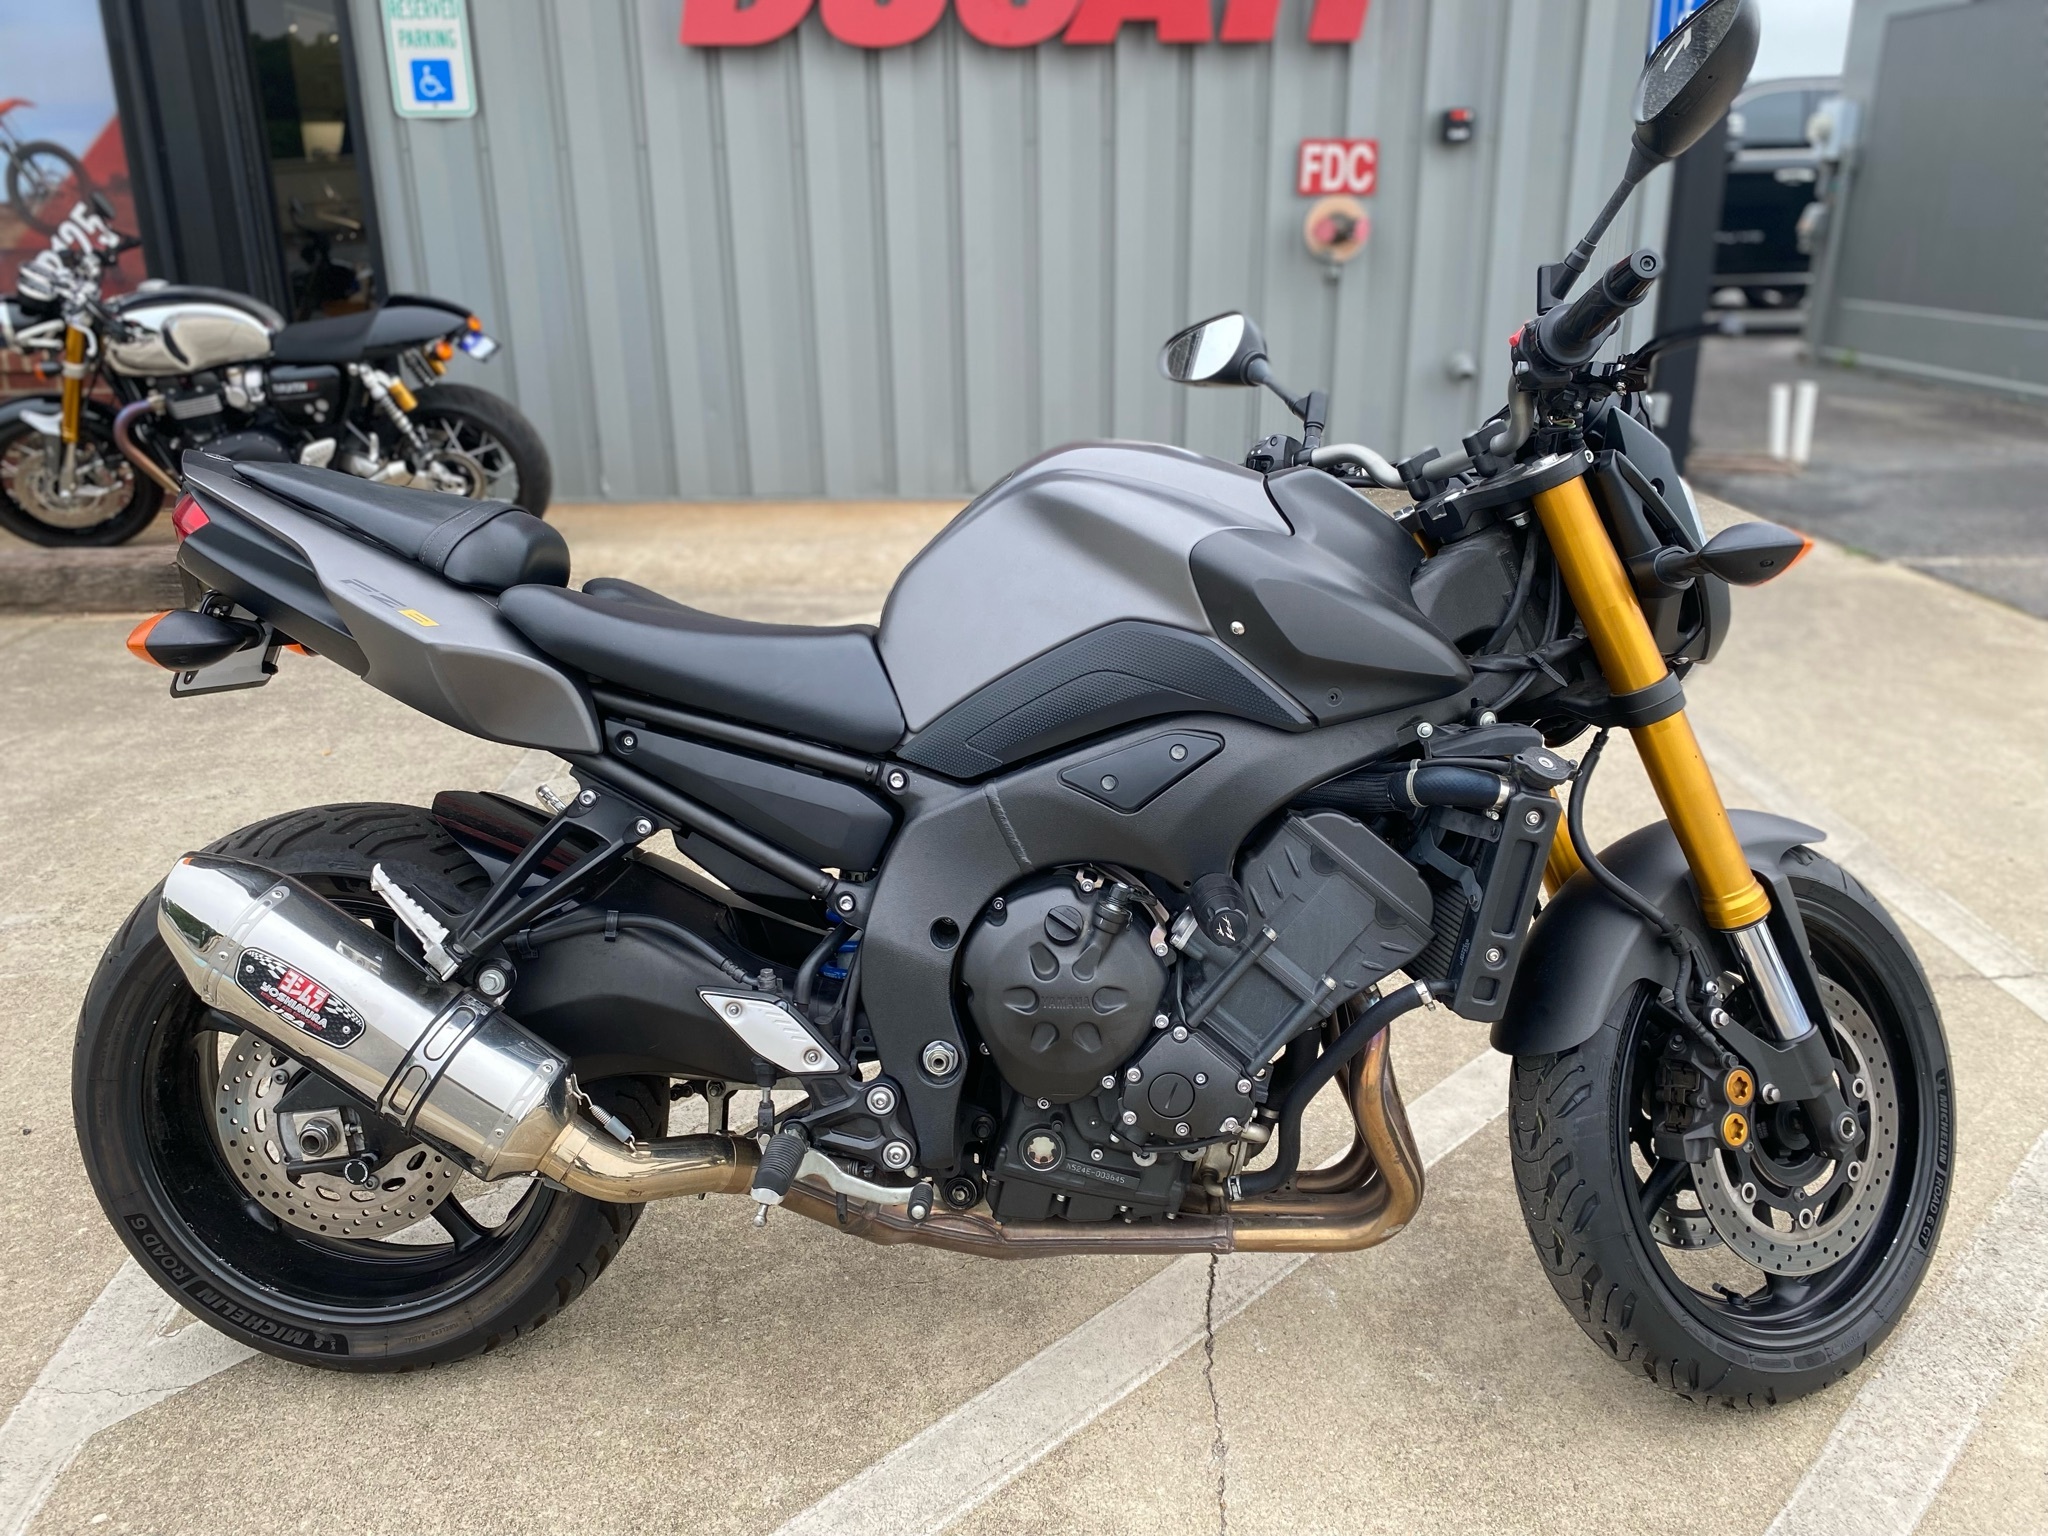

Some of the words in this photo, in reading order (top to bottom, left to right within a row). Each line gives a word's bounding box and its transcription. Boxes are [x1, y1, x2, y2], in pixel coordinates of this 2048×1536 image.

[387, 0, 459, 19] RESERVED
[398, 28, 456, 49] PARKING
[1301, 144, 1375, 192] FDC
[260, 981, 328, 1029] YOSHIMURA
[279, 970, 329, 1011] ヨシムラ
[1041, 996, 1090, 1009] YAMAHA
[270, 1004, 306, 1028] USA
[1938, 1093, 1949, 1165] MICHELIN
[1928, 1177, 1944, 1215] ROAD
[130, 1216, 148, 1230] 6
[1919, 1226, 1933, 1244] GT
[142, 1234, 192, 1280] ROAD
[196, 1283, 309, 1346] MICHELIN
